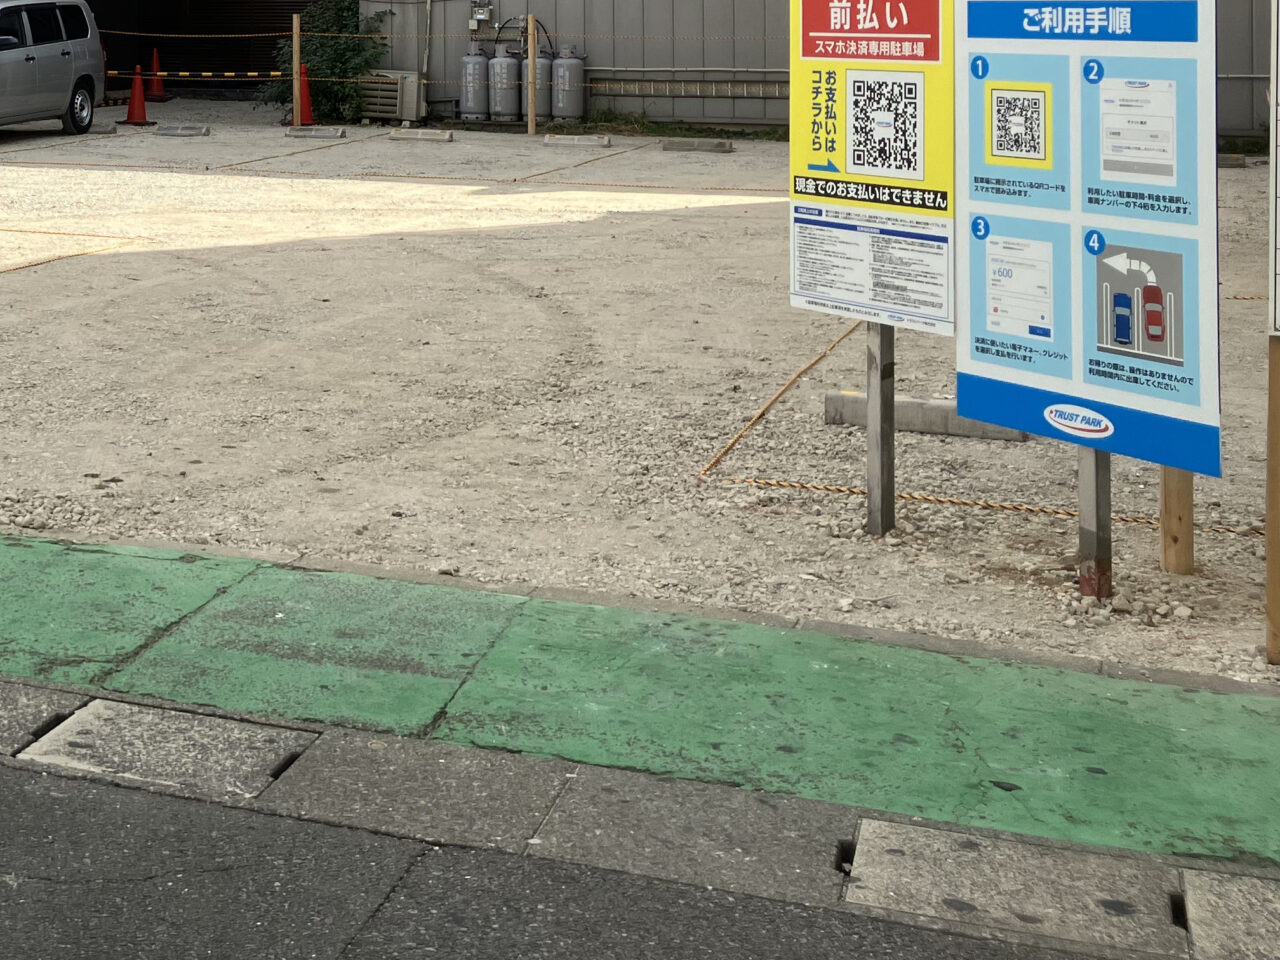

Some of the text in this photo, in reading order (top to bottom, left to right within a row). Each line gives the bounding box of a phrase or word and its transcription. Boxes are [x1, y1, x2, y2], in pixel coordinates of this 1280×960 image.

[1022, 7, 1132, 35] ご利用手順
[814, 40, 925, 57] スマホ決済専用駐車場
[1088, 62, 1099, 80] 2
[811, 70, 823, 152] コチラから
[824, 70, 837, 153] お支払いは
[795, 178, 947, 208] 現金でのお支払いはできません
[977, 219, 985, 236] 3
[1089, 233, 1100, 251] 4
[1053, 409, 1104, 429] TRUST PARK
